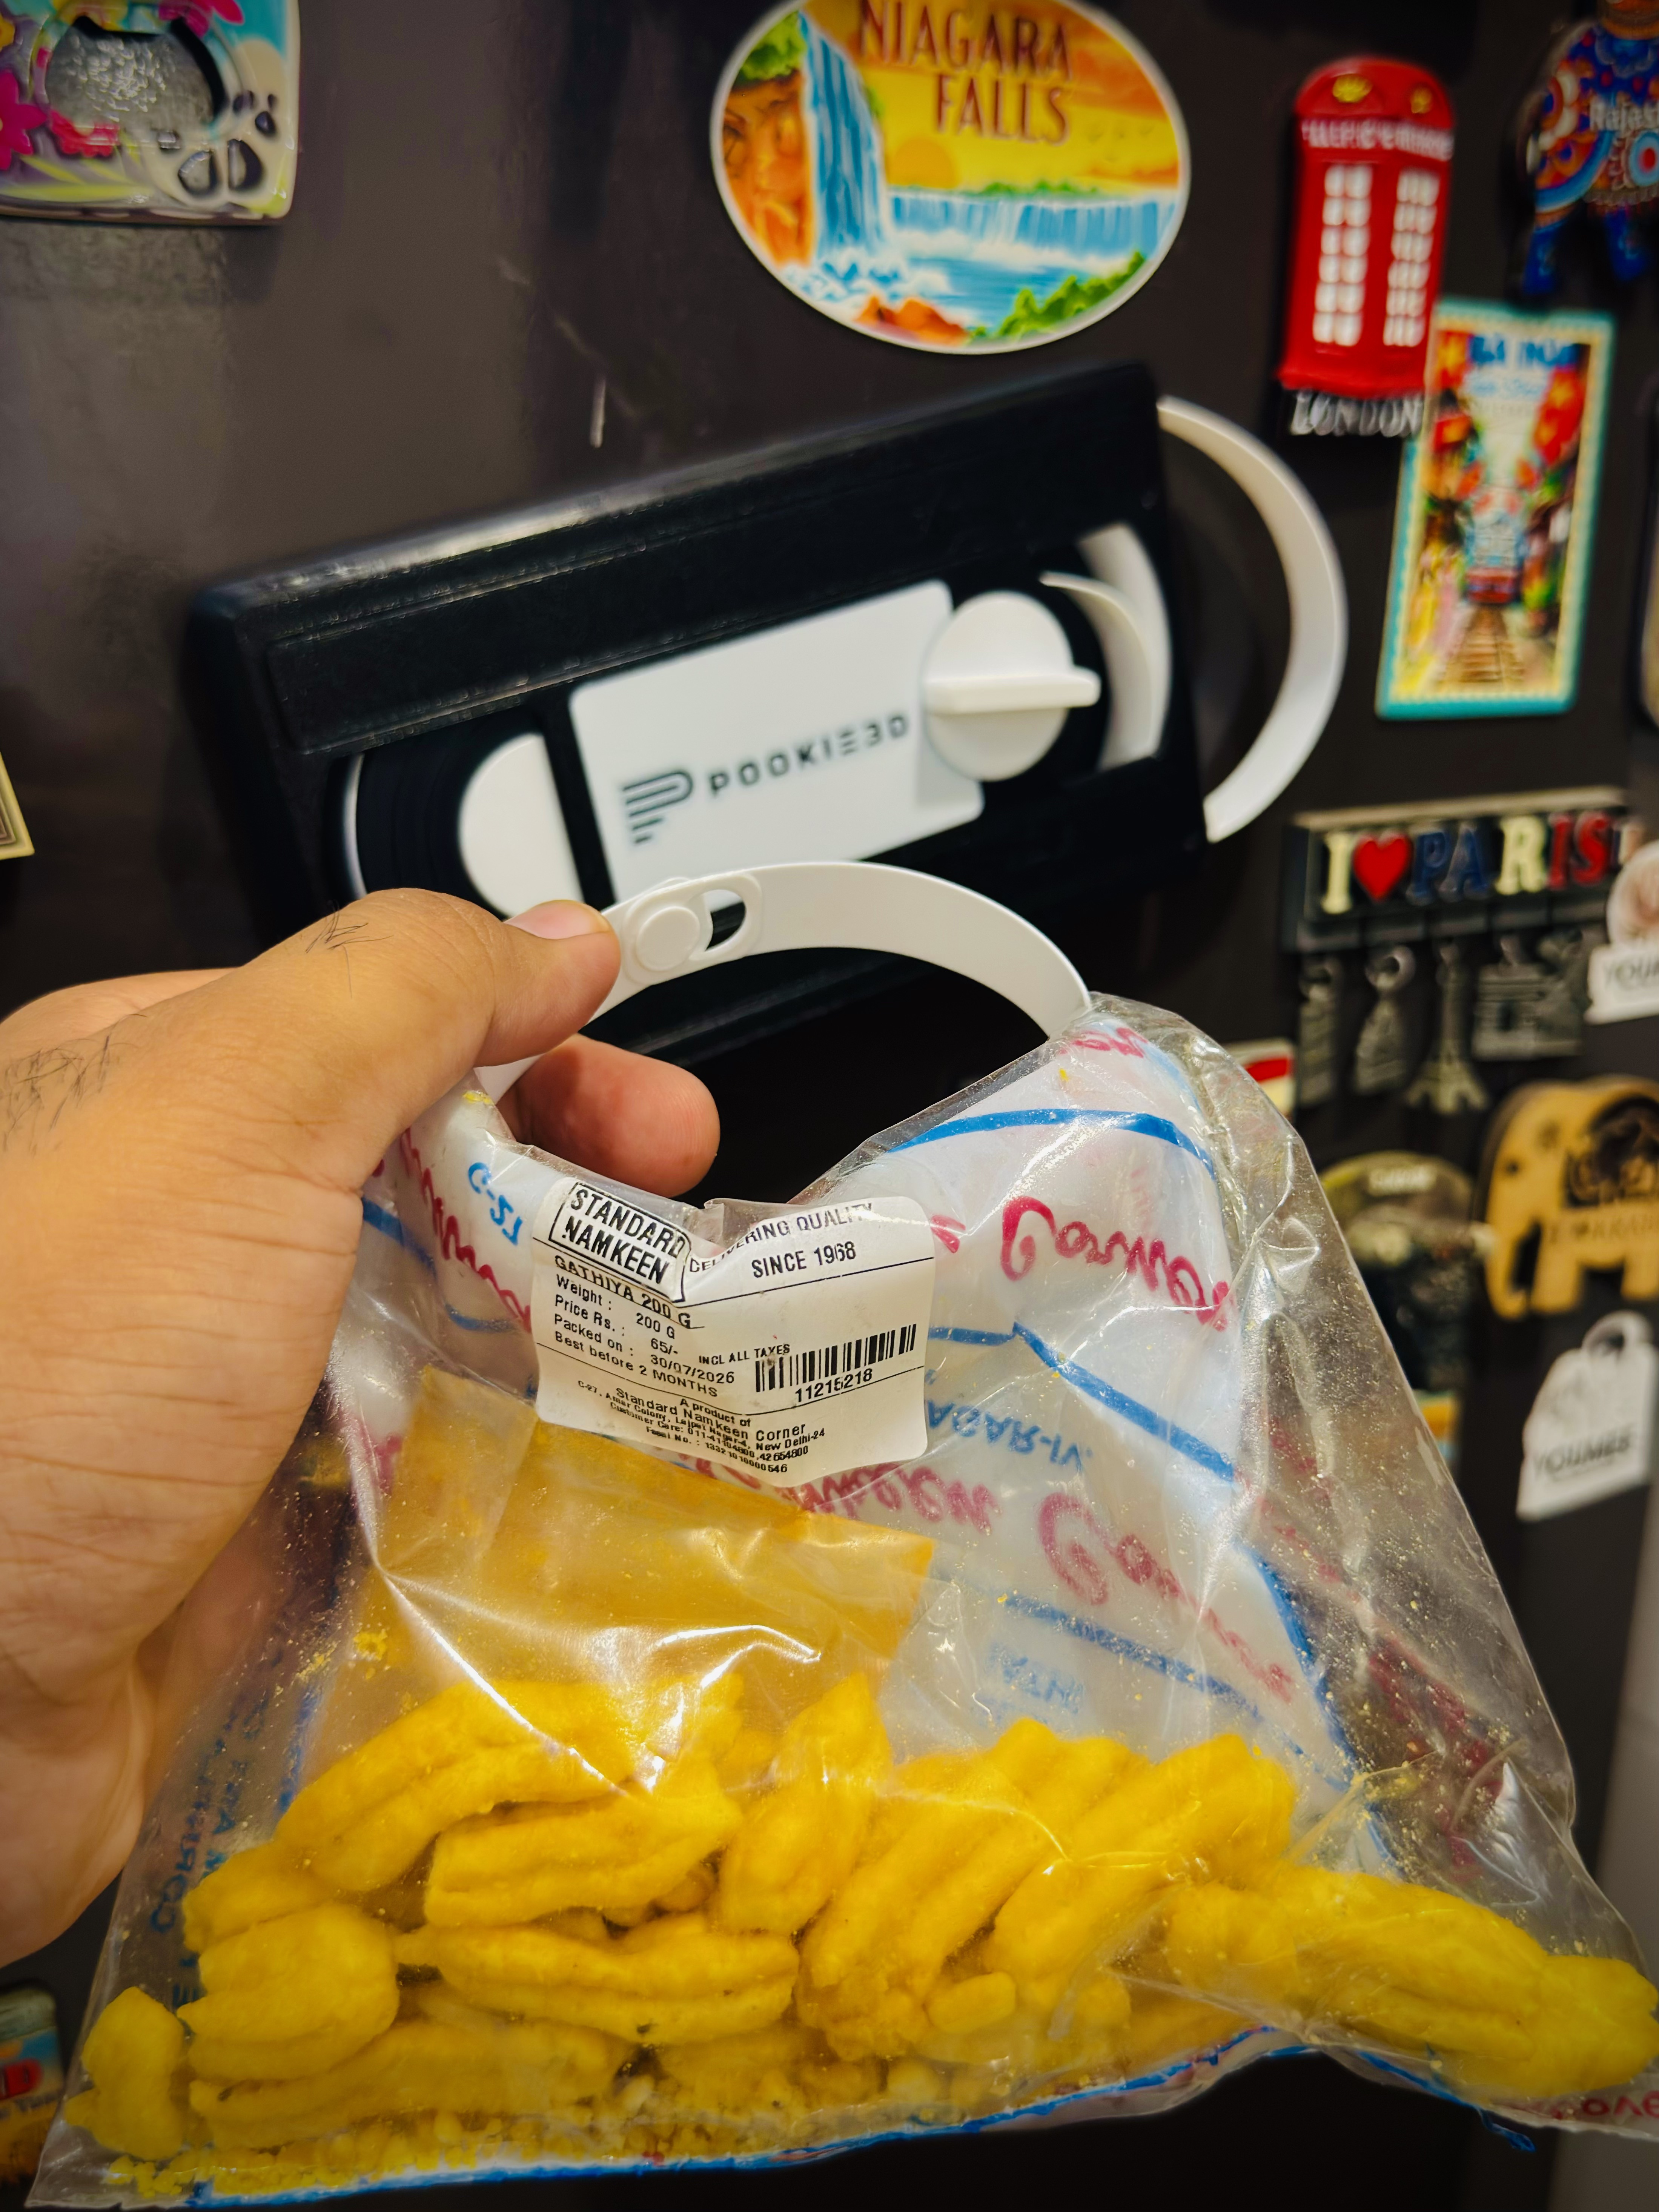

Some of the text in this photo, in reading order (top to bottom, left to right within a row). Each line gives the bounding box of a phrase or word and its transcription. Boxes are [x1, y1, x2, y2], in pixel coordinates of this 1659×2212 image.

[860, 0, 1072, 80] NIAGARA
[936, 73, 1069, 146] FALLS
[1321, 810, 1611, 914] I PARIS
[562, 1215, 670, 1284] NAMKEEN
[571, 1189, 686, 1259] STANDARD
[555, 1255, 691, 1329] GATHIYA 200 G
[751, 1241, 857, 1278] SINCE 1968
[555, 1294, 588, 1320] Price
[594, 1311, 615, 1332] Rs.
[651, 1338, 679, 1355] 65/-
[699, 1355, 725, 1365] INCL
[729, 1350, 750, 1363] ALL
[754, 1344, 790, 1358] TAXES
[556, 1273, 602, 1306] Weight
[636, 1312, 661, 1332] 200
[667, 1326, 675, 1339] G
[554, 1313, 602, 1344] Packed
[607, 1339, 622, 1353] on
[651, 1354, 735, 1384] 30/07/2026
[555, 1331, 718, 1398] Best before 2 MONTHS
[610, 1401, 654, 1425] Customer
[616, 1387, 806, 1441] Standard Namkeen Corner
[680, 1398, 751, 1427] A product of
[795, 1368, 873, 1402] 11215218
[606, 1393, 631, 1408] Amar
[756, 1442, 781, 1451] New
[785, 1427, 825, 1449] Delhi-24
